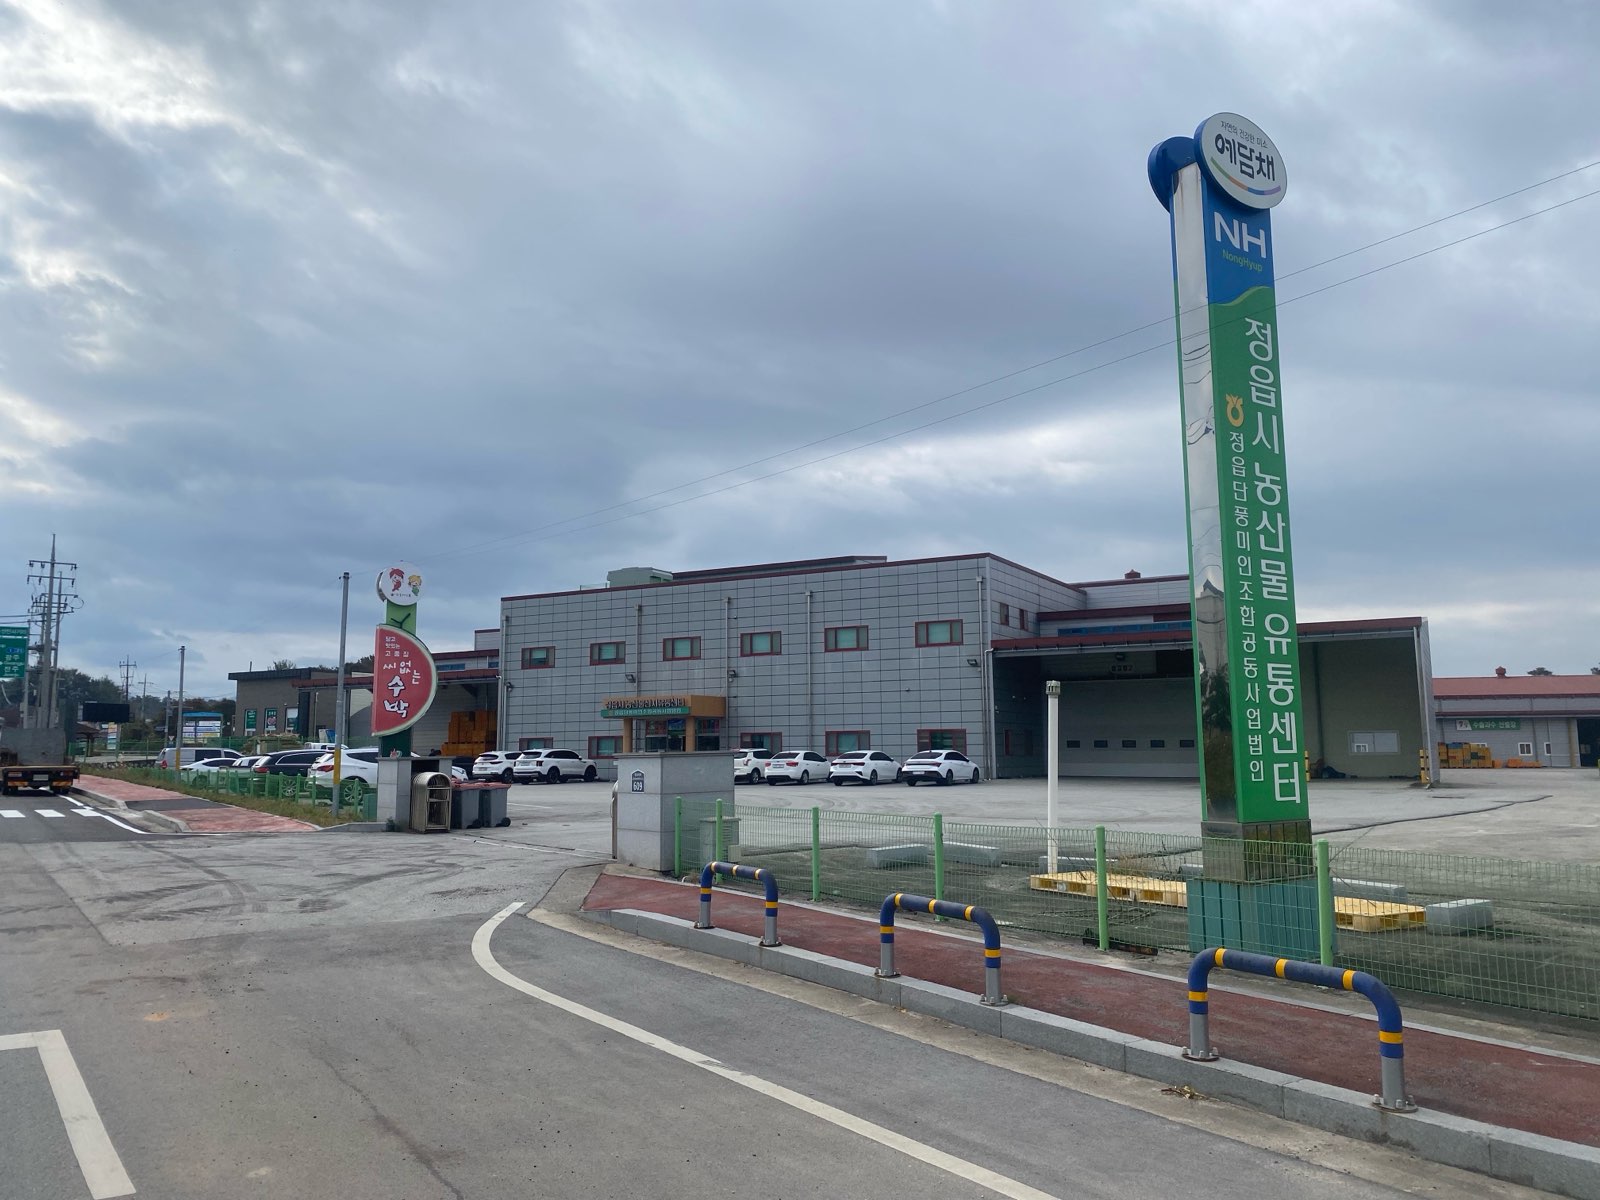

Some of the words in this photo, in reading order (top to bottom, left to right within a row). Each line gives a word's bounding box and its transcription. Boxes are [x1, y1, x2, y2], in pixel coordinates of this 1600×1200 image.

[1215, 133, 1275, 181] 예담채
[1256, 137, 1268, 149] 미소
[1213, 211, 1267, 259] NH
[1222, 249, 1263, 273] NongHyup
[383, 675, 409, 718] 수박
[633, 781, 643, 791] 609
